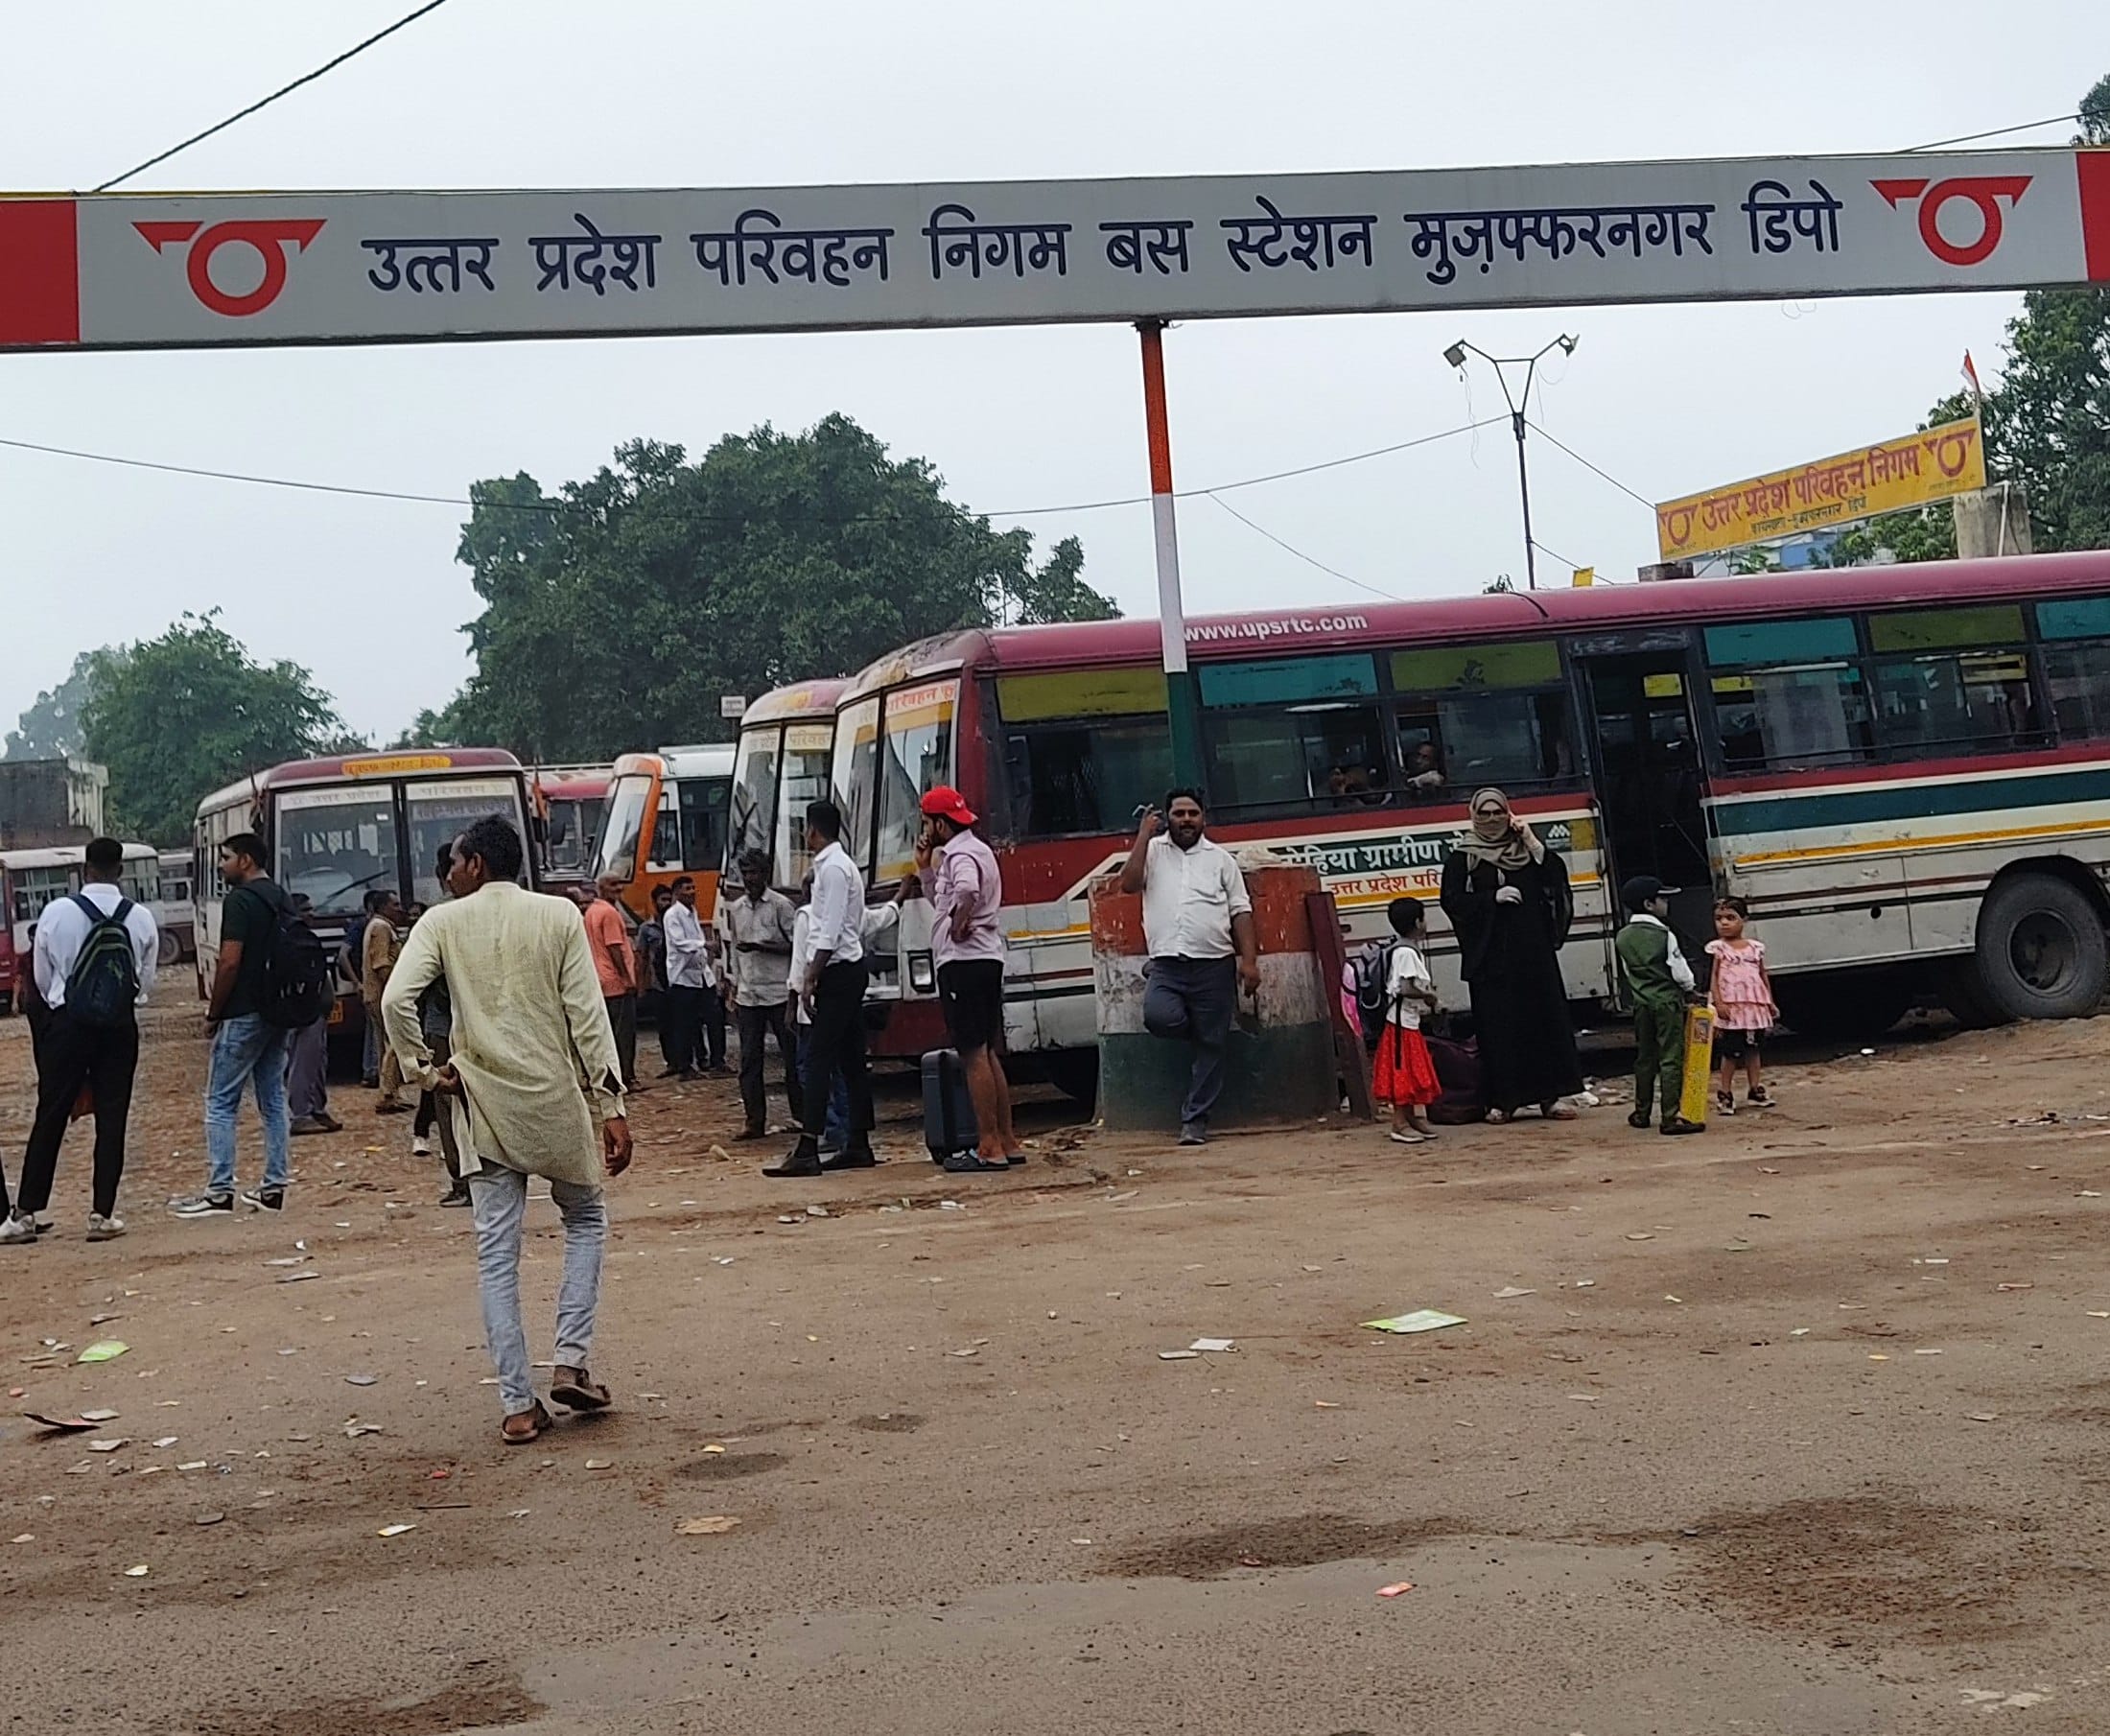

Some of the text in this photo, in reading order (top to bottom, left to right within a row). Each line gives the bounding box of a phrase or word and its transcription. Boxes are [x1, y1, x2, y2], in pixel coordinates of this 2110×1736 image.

[361, 237, 501, 293] उत्तर
[528, 212, 663, 296] प्रदेश
[689, 208, 896, 287] परिवहन
[921, 203, 1073, 280] निगम
[1098, 220, 1195, 275] बस
[1219, 195, 1379, 273] स्टेशन
[1740, 178, 1844, 254] डिपो
[1702, 492, 1742, 531] उत्तर
[1744, 479, 1791, 518] प्रदेश
[1793, 466, 1866, 504] परिवहन
[1867, 446, 1920, 486] निगम
[1184, 614, 1368, 641] www.upsrtc.com
[1359, 835, 1442, 868] ग्रामीण
[1327, 870, 1444, 895] उत्तर प्रदेश परि
